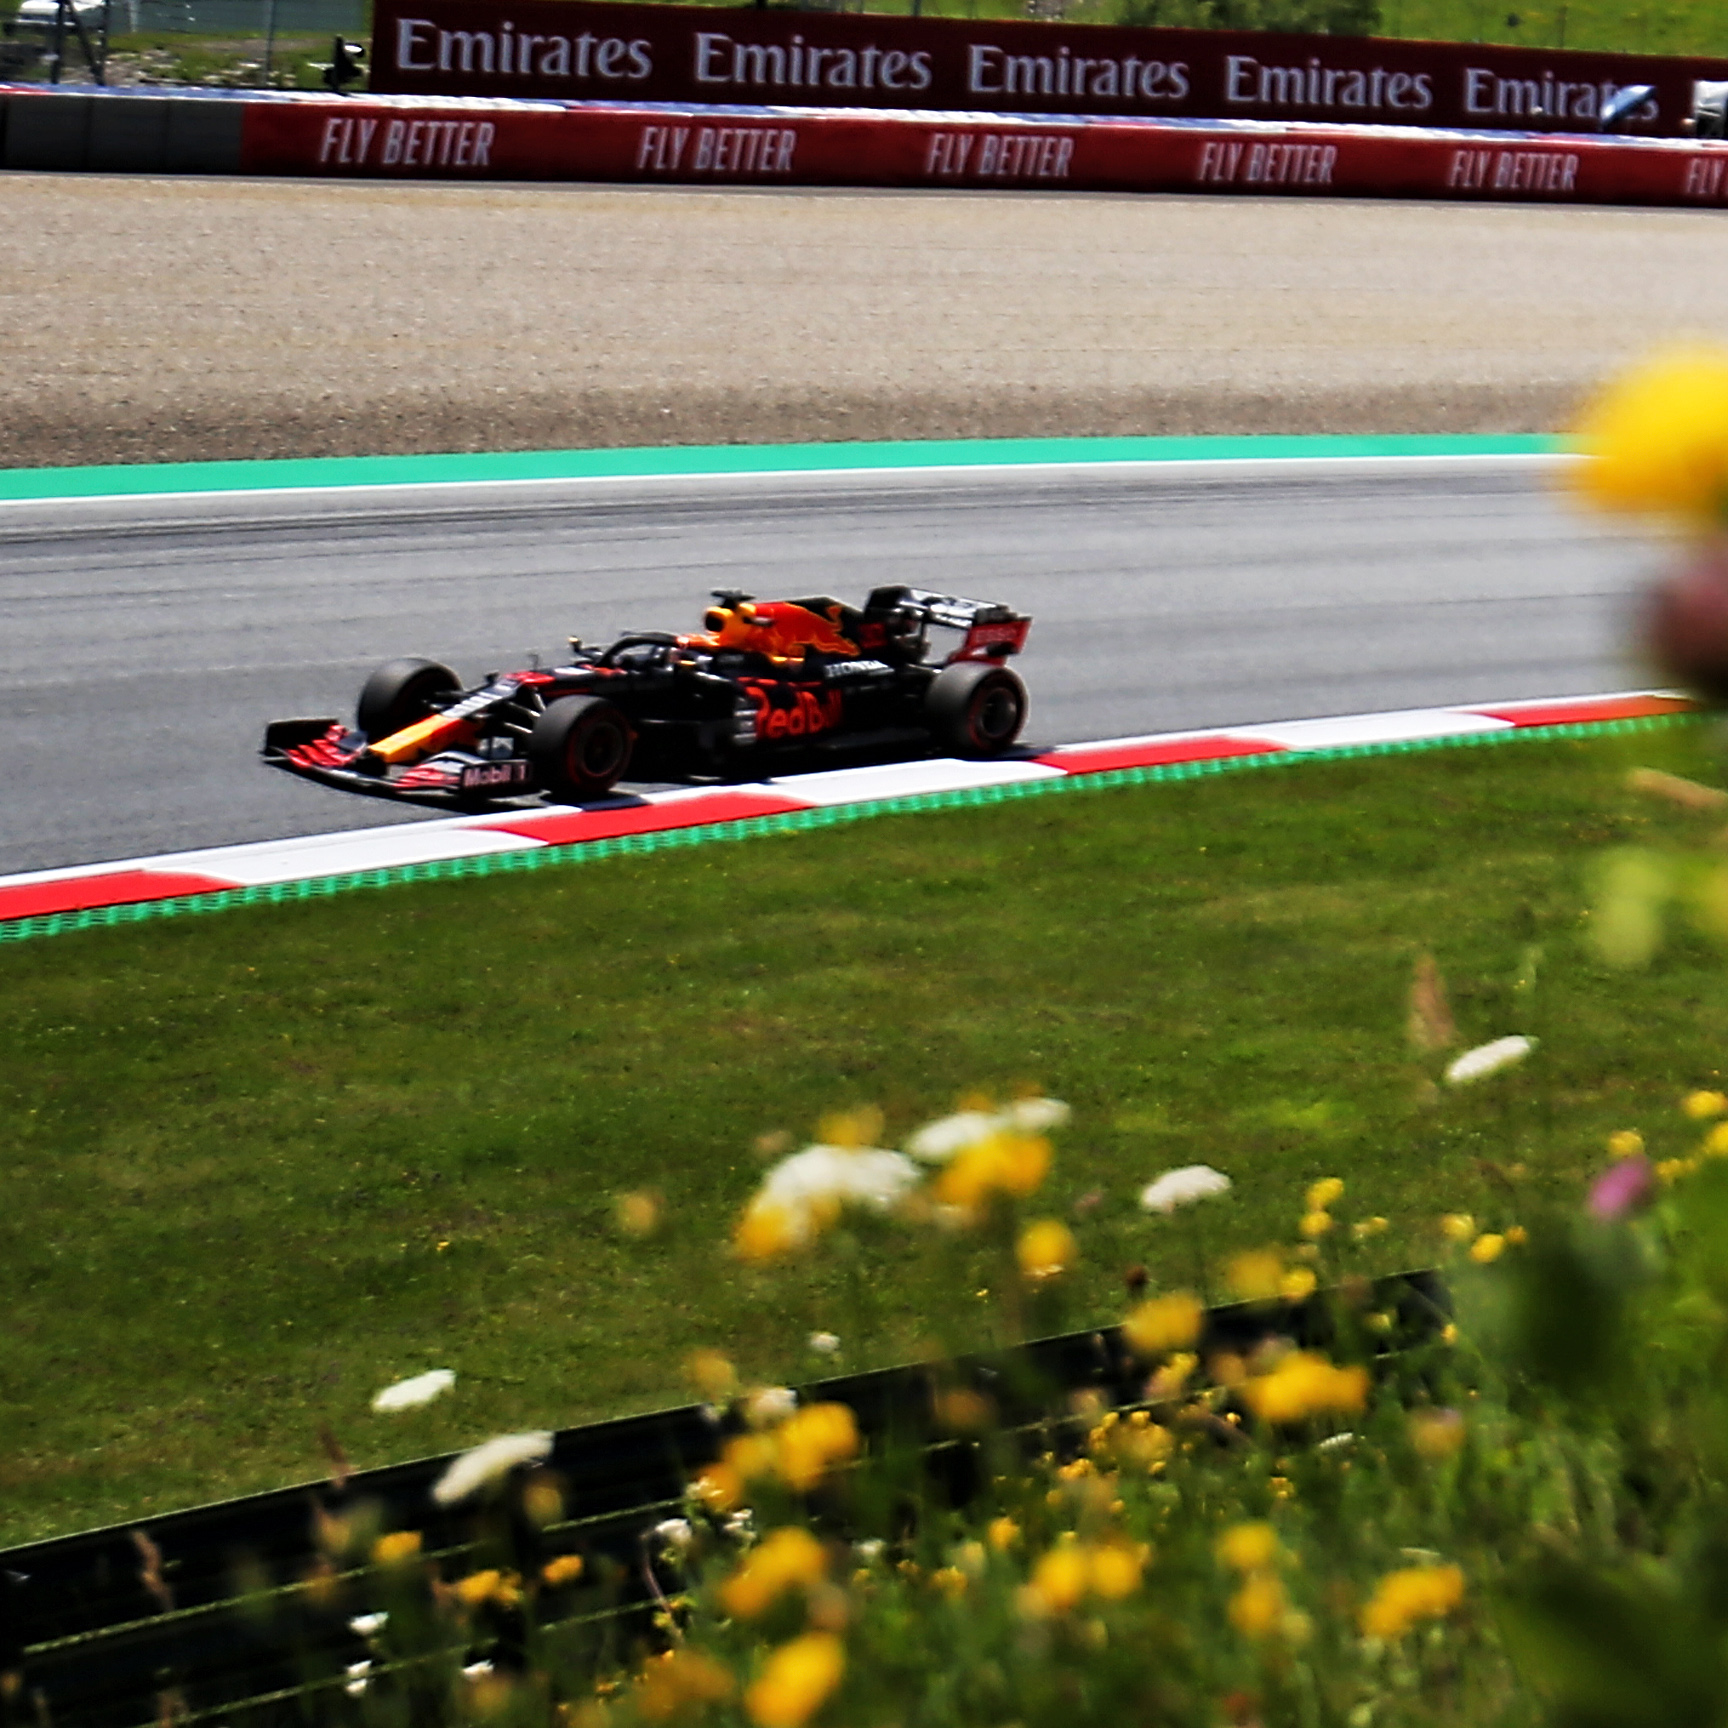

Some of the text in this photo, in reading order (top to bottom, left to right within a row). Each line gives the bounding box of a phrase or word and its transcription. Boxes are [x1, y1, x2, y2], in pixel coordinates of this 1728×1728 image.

[397, 18, 652, 79] Emirates
[695, 32, 932, 89] Emirates
[968, 44, 1190, 98] Emirates
[1226, 55, 1433, 109] Emirates
[1464, 68, 1659, 121] Emirats
[319, 117, 496, 166] FLY BETTER
[636, 125, 797, 172] FLY BETTER
[927, 132, 1075, 178] FLY BETTER
[1199, 141, 1338, 185] FLY BETTER
[1449, 149, 1579, 192] FLY BETTER
[1686, 156, 1728, 197] FLY
